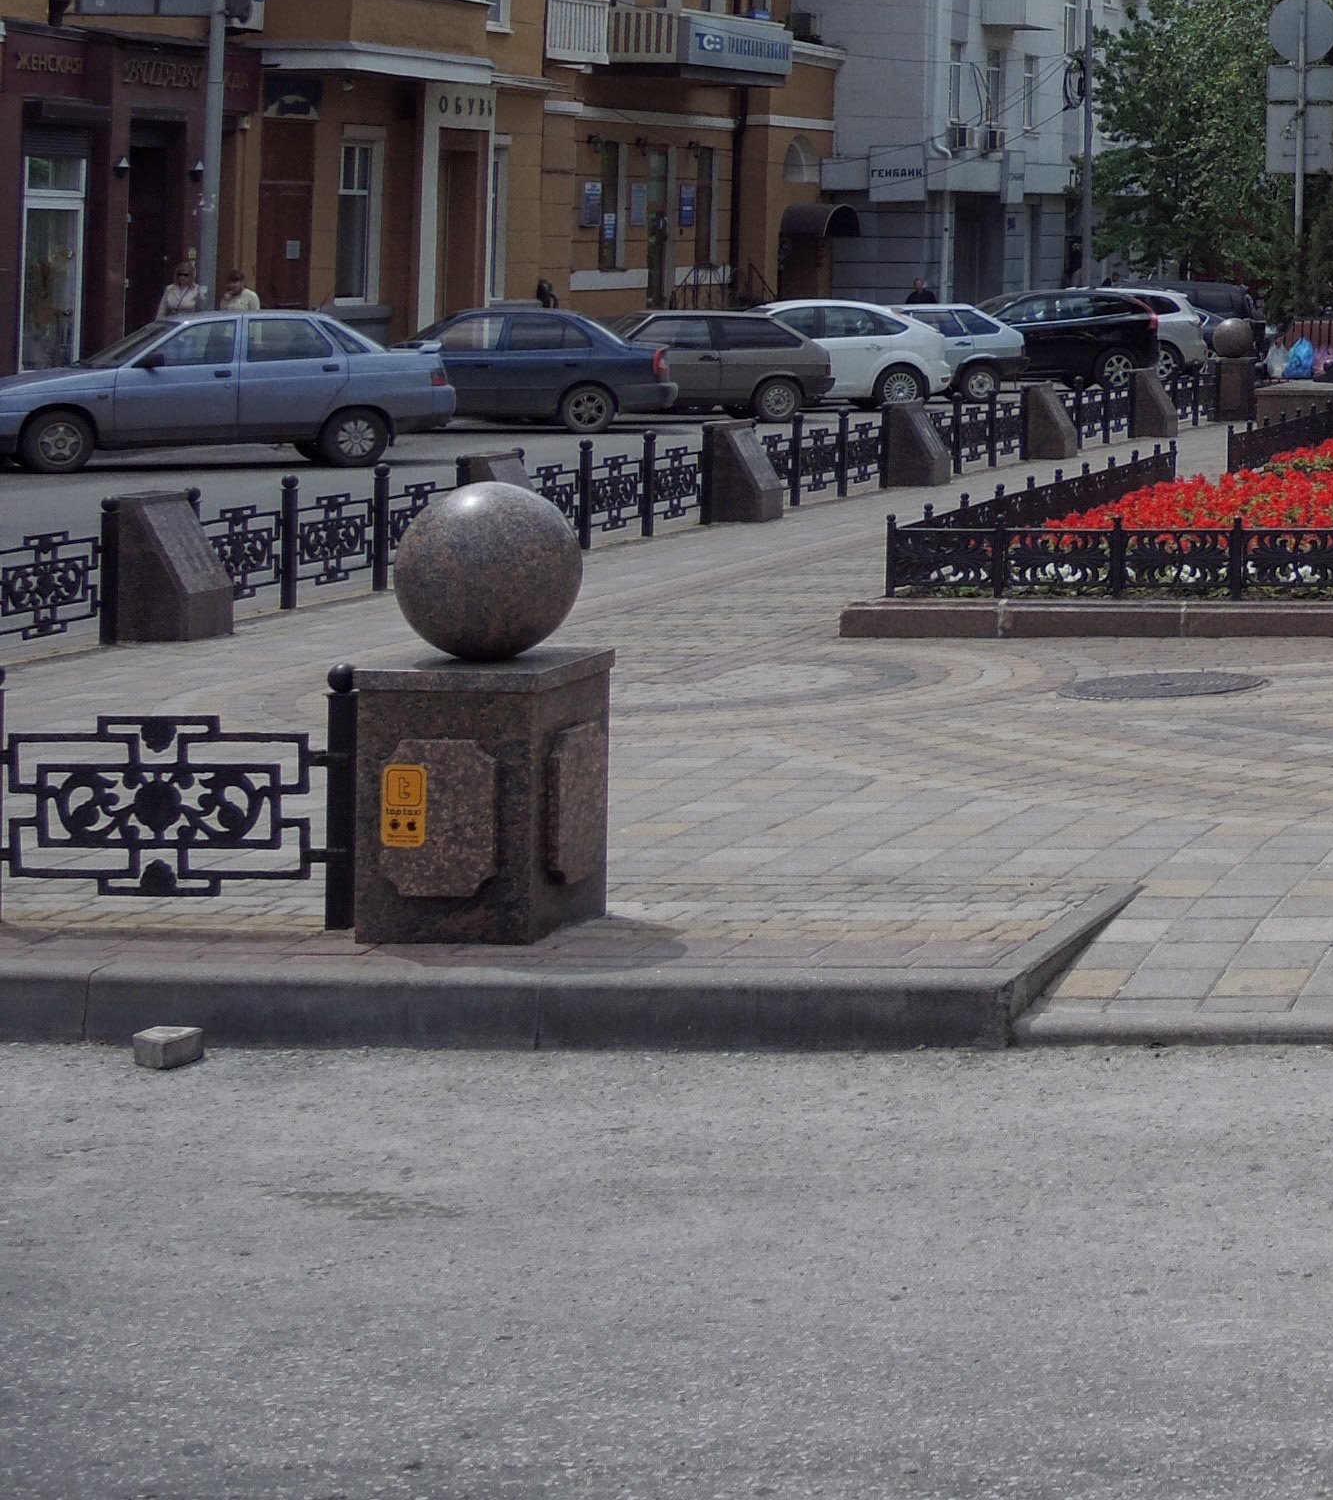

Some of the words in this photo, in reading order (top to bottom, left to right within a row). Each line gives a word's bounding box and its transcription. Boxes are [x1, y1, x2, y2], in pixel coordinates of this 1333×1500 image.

[16, 52, 83, 74] ЖЕНСКАЯ
[439, 95, 493, 117] ОБУВЬ
[871, 167, 923, 178] ГЕНБАНК
[403, 808, 422, 816] taxi
